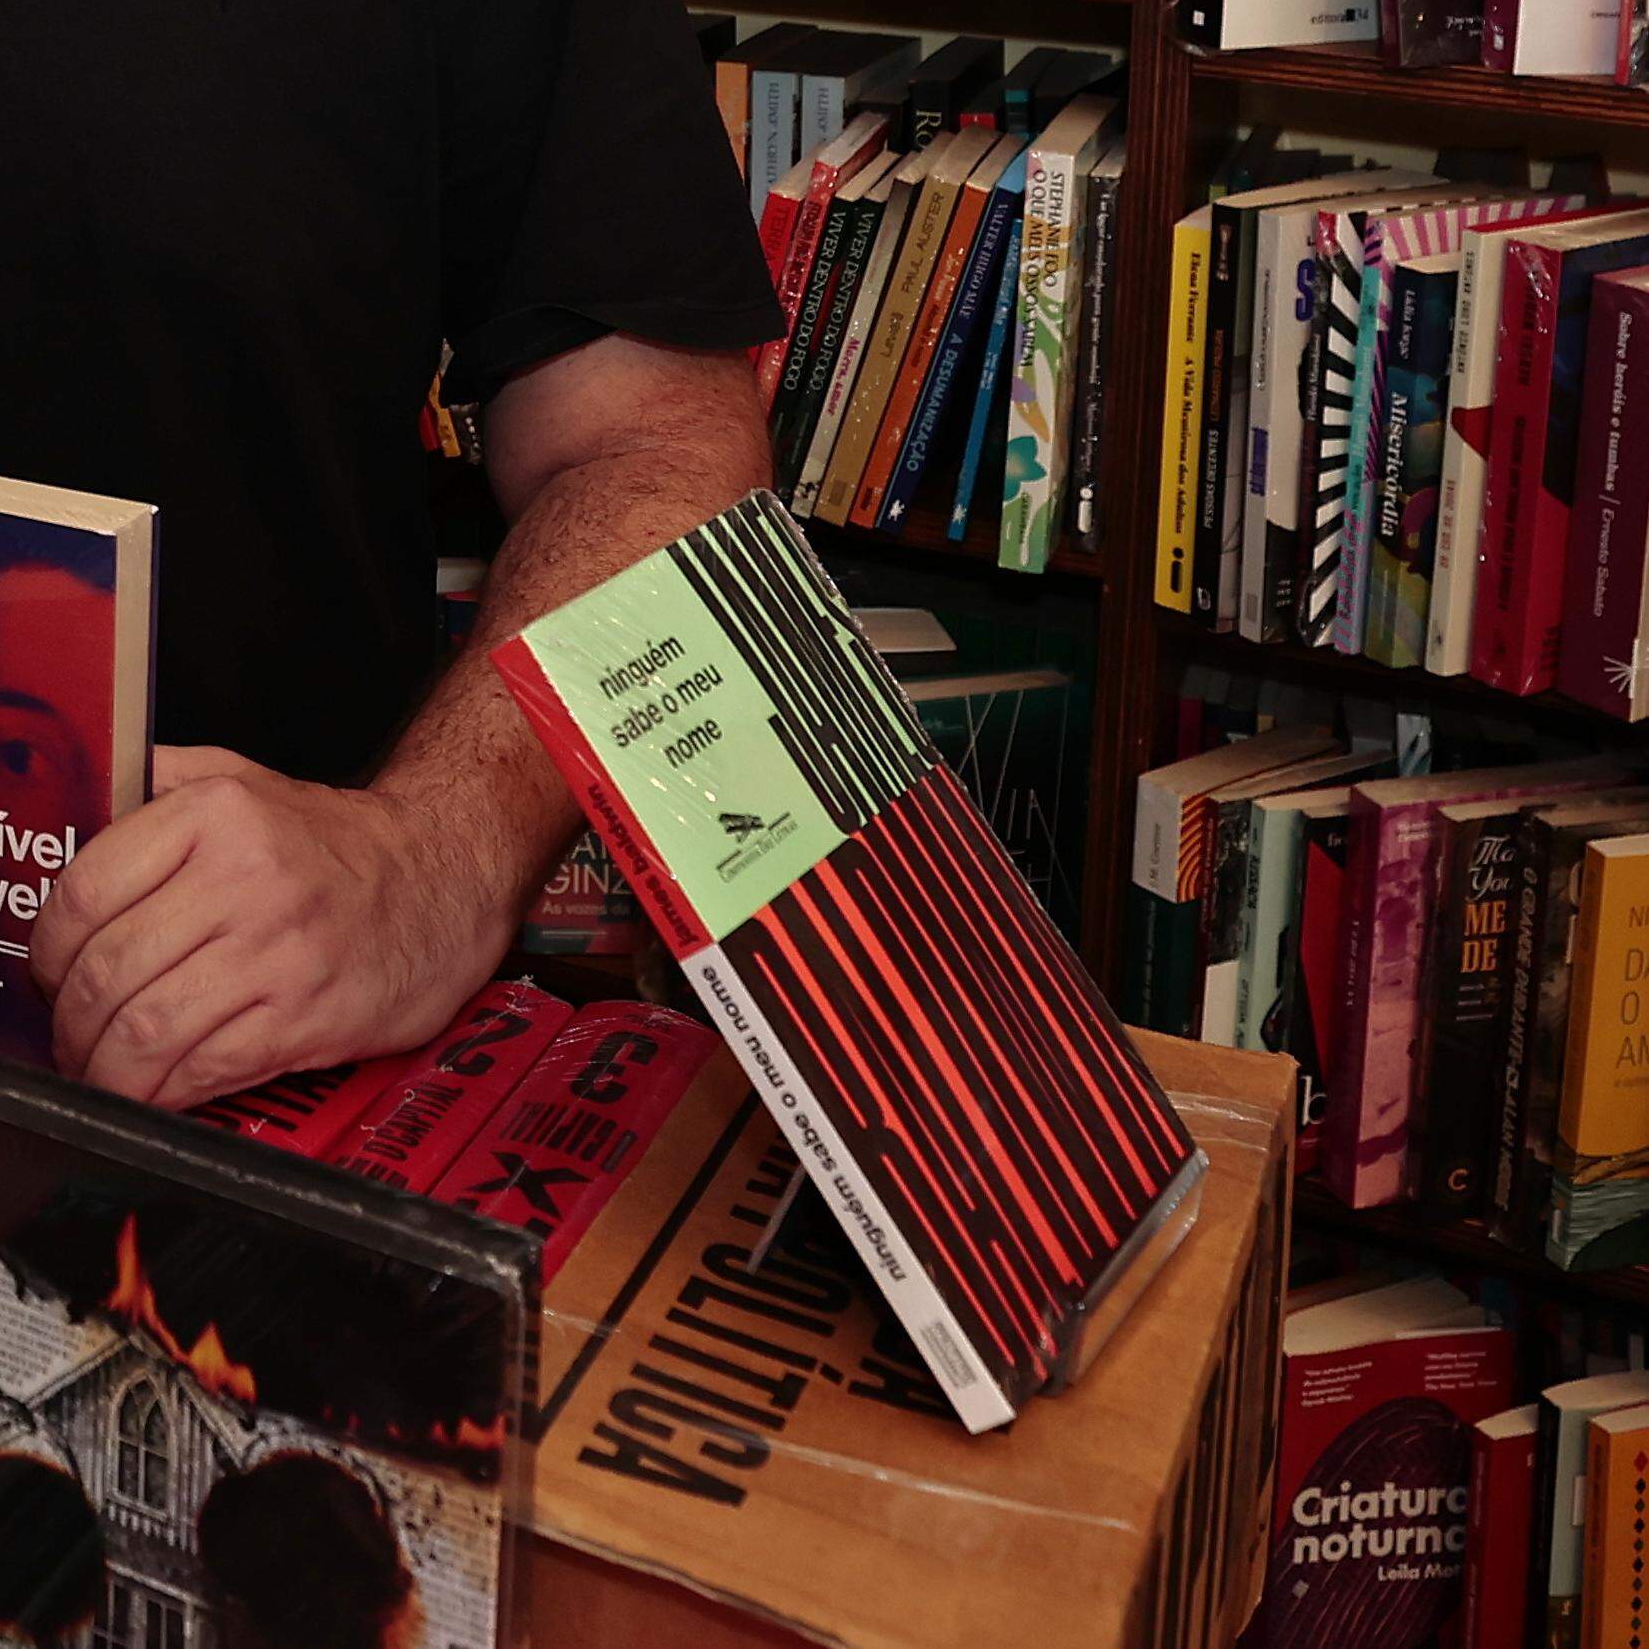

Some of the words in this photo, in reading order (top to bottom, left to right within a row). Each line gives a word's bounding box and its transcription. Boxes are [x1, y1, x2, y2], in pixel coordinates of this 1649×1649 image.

[1033, 169, 1046, 182] O
[1029, 186, 1046, 219] QUE
[1047, 171, 1064, 246] STEPHANIE
[824, 211, 846, 259] VIVER
[852, 212, 875, 263] VIVER
[903, 261, 924, 295] PAUL
[916, 193, 944, 257] AUSTER
[1025, 221, 1043, 264] MEUS
[803, 261, 830, 324] DENTRO
[1044, 246, 1060, 287] FOO
[1188, 252, 1200, 288] Elena
[831, 263, 855, 324] DENTRO
[796, 325, 814, 349] DO
[949, 332, 963, 345] A
[1615, 311, 1633, 361] Sobre
[784, 352, 804, 391] FOGO
[1611, 362, 1629, 414] heróis
[907, 347, 958, 472] DESUMANIZAÇÃO
[1610, 416, 1621, 428] e
[1379, 390, 1410, 537] Misericórdia
[1606, 431, 1623, 492] tumbas
[1597, 508, 1616, 564] Ernesto
[600, 635, 687, 700] ninguém
[610, 702, 664, 749] sabe
[662, 693, 679, 713] o
[677, 663, 724, 704] meu
[663, 717, 723, 769] nome
[587, 783, 650, 876] baldwin
[645, 872, 700, 945] james
[1465, 900, 1508, 936] ME
[1461, 939, 1498, 973] DE
[701, 963, 750, 1034] nome
[1620, 991, 1640, 1026] O
[435, 1007, 534, 1077] 2
[747, 1032, 787, 1087] meu
[778, 1089, 799, 1110] o
[794, 1110, 838, 1175] sabe
[832, 1171, 908, 1284] ninguém
